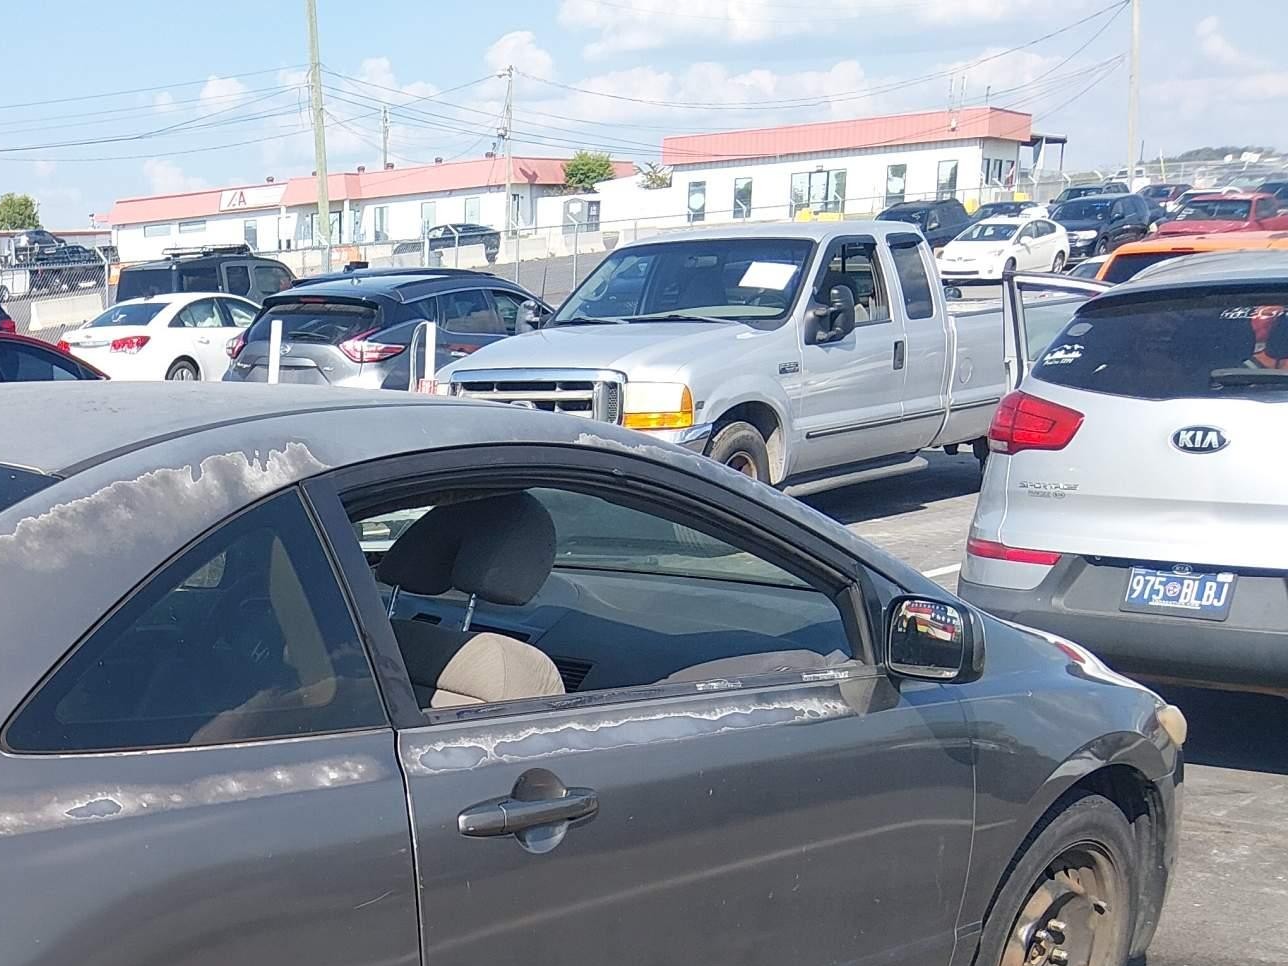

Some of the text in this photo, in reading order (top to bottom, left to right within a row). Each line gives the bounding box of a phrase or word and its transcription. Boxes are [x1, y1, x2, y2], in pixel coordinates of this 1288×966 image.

[1178, 430, 1219, 448] KIA
[1131, 575, 1229, 607] 975 BLBJ
